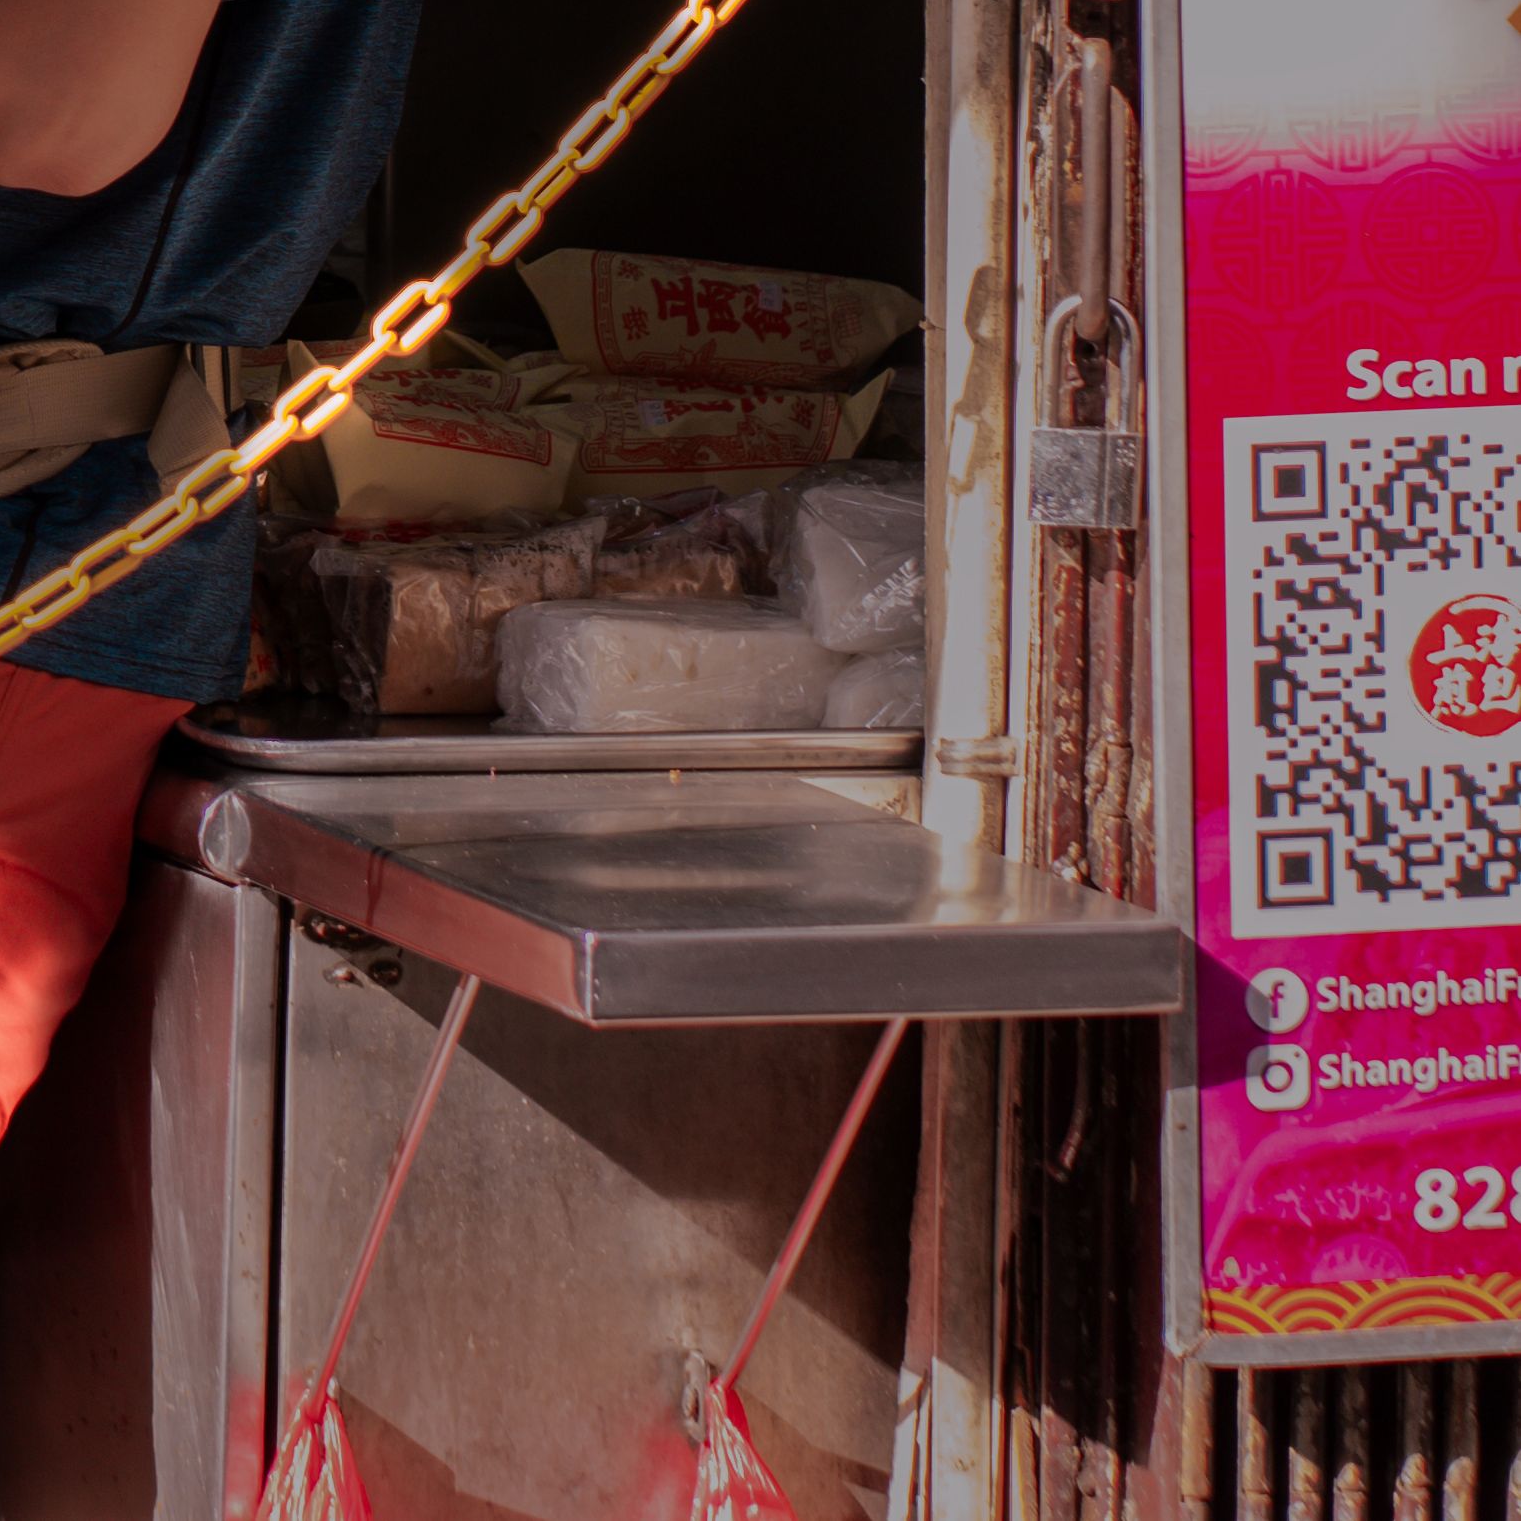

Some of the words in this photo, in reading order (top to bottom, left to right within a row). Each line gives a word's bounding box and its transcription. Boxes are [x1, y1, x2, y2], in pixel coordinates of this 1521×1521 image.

[1345, 348, 1489, 401] Scan
[1315, 967, 1521, 1017] ShanghaiF
[1317, 1044, 1521, 1094] ShanghaiF
[1413, 1165, 1521, 1234] 82
